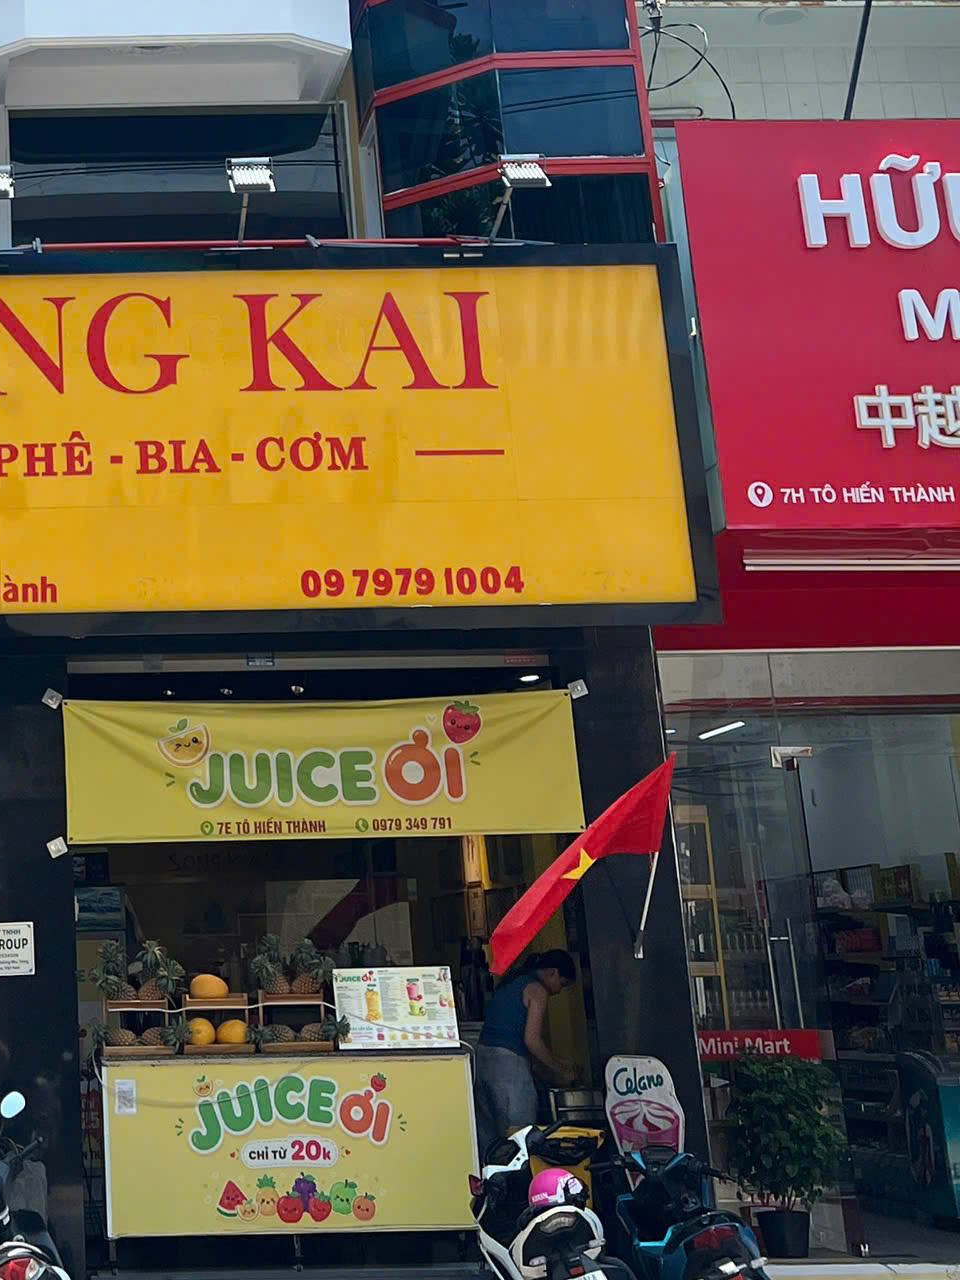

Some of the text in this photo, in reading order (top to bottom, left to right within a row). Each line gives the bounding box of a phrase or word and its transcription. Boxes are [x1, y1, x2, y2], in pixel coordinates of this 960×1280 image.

[797, 153, 960, 249] HỮ
[233, 290, 499, 393] KAI
[135, 438, 222, 475] BIA
[256, 431, 369, 473] CƠM
[780, 480, 956, 504] 7H TÔ HIẾN THÀNH
[189, 749, 379, 806] JUICE
[217, 817, 327, 835] 7E TÔ HIẾN THÀNH
[372, 816, 452, 832] 0979 349 791
[698, 1037, 792, 1055] Mini Mart
[613, 1067, 664, 1096] Celano
[191, 1074, 336, 1151] JUICE
[248, 1139, 331, 1161] CHỈ TỪ 20k
